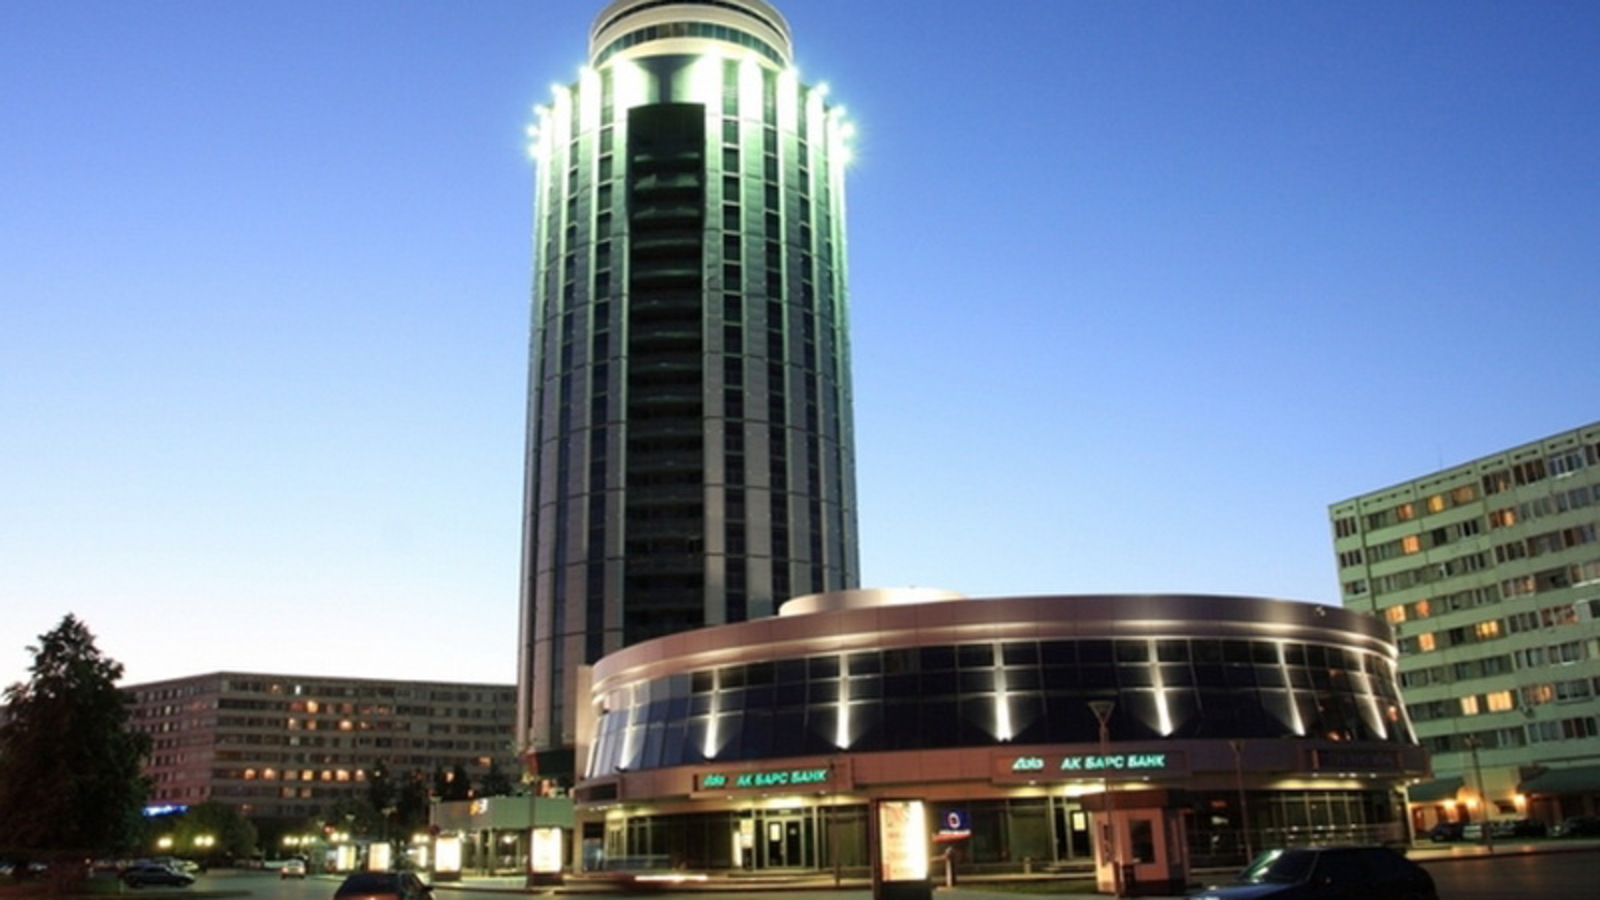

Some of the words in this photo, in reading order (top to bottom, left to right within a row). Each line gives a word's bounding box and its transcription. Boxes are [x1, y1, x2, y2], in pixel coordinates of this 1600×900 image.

[1060, 757, 1081, 770] АК
[1084, 755, 1124, 769] БАРС
[1127, 754, 1165, 768] БАНК
